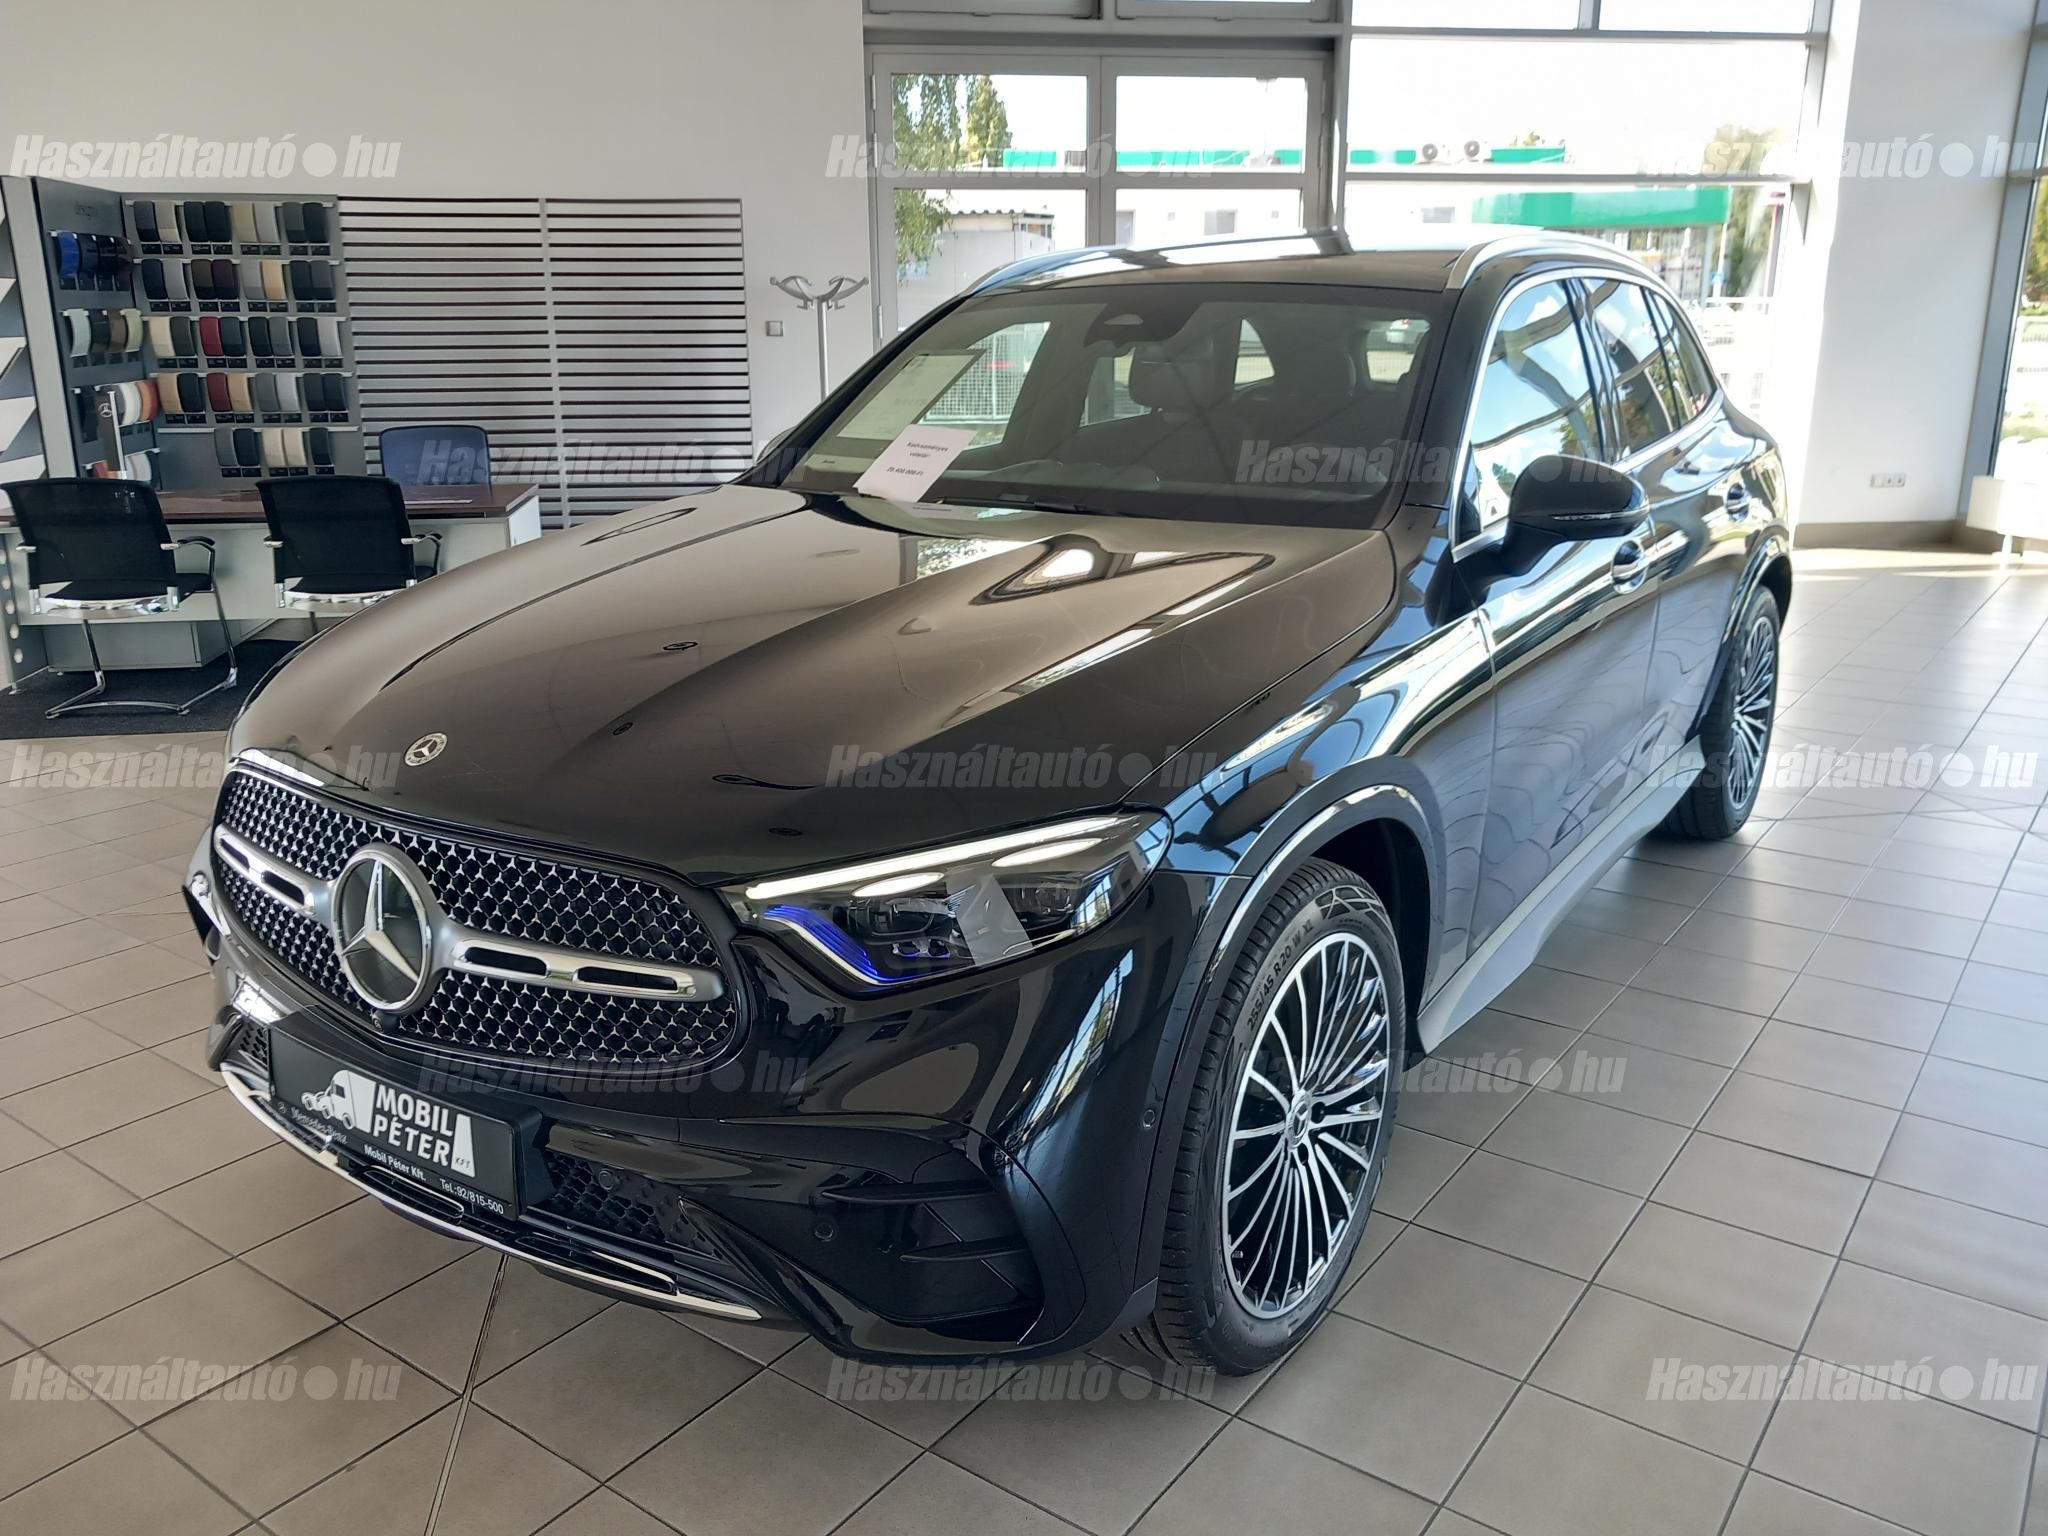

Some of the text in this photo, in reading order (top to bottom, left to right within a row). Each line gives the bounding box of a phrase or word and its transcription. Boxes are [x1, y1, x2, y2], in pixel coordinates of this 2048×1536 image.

[375, 1084, 454, 1138] MOBIL
[364, 1144, 388, 1166] Mobil
[387, 1156, 411, 1175] Péter
[410, 1166, 427, 1181] Kft.
[373, 1114, 451, 1167] PÉTER
